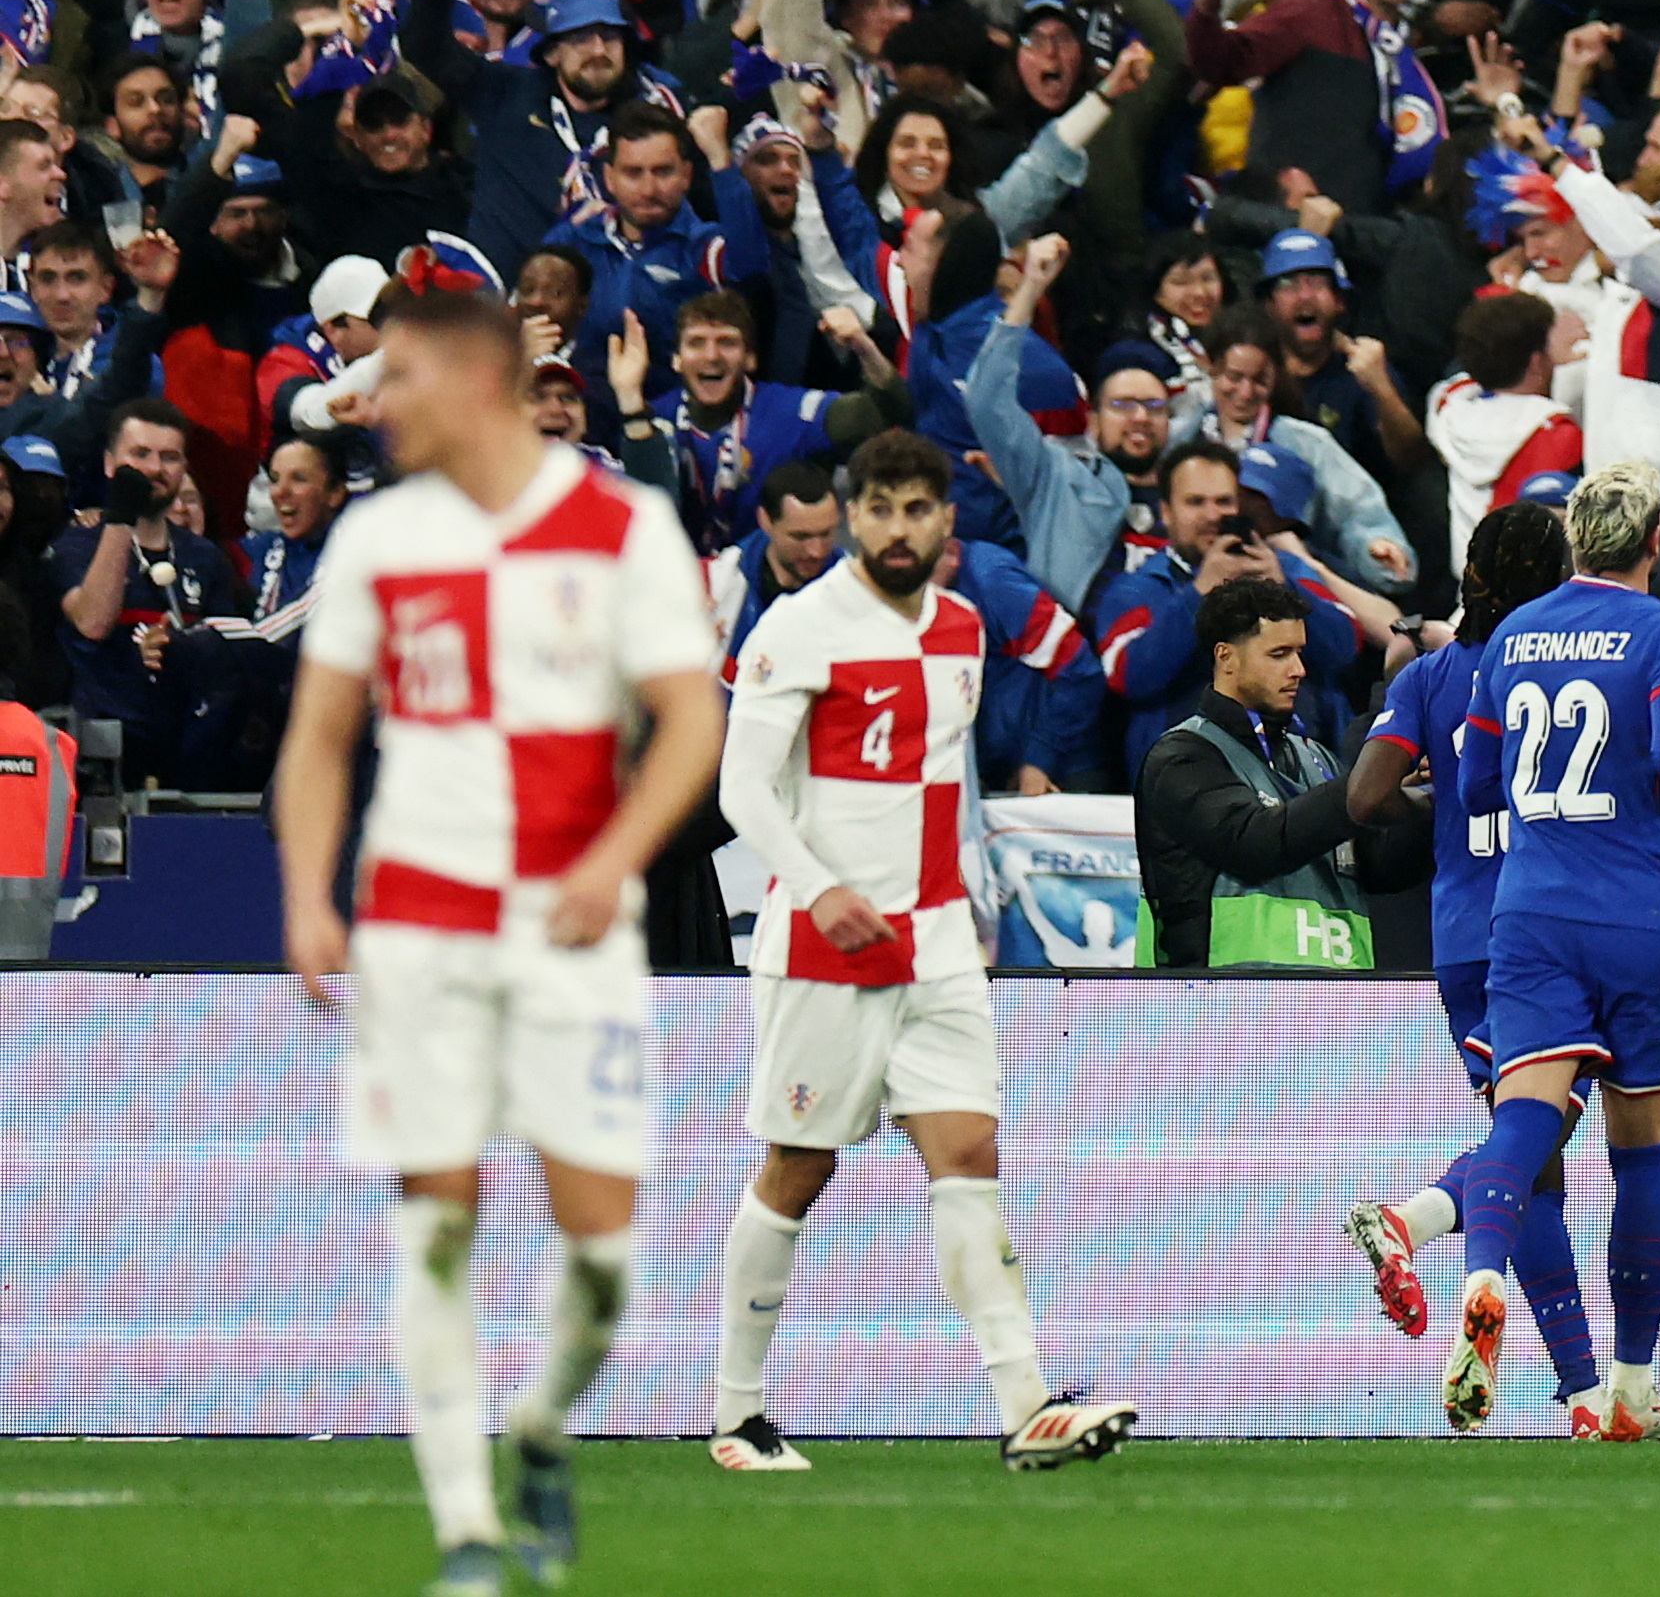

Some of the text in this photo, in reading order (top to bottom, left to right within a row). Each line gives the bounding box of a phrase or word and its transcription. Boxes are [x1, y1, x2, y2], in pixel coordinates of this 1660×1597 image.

[1503, 631, 1632, 666] T.HERNANDEZ
[861, 708, 896, 772] 4
[1505, 678, 1616, 823] 22
[1296, 907, 1354, 966] HB
